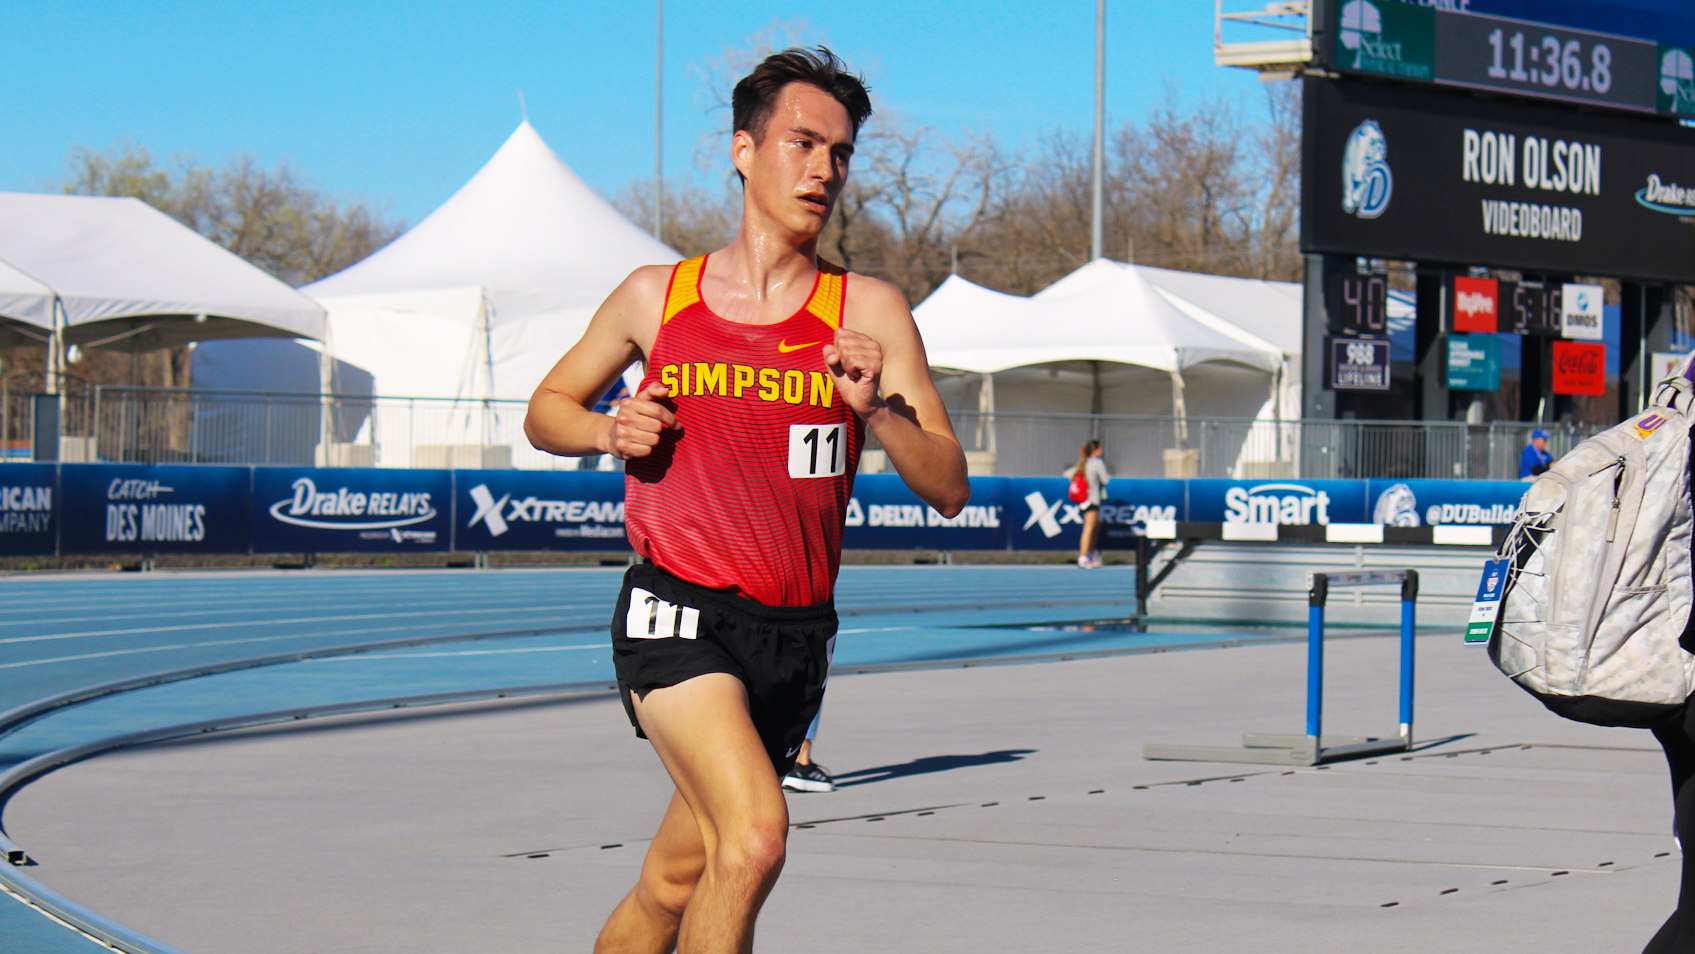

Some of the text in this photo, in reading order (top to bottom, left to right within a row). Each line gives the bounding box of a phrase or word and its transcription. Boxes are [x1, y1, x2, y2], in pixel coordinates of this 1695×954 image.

[1488, 28, 1611, 94] 11:36.8
[1463, 128, 1601, 196] RON OLSON
[1645, 173, 1685, 205] Drake
[1482, 199, 1582, 242] VIDEOBOARD
[1344, 278, 1385, 329] 40
[1346, 343, 1375, 365] 988
[661, 362, 834, 409] SIMPSON
[803, 427, 839, 475] 11
[0, 486, 52, 511] ICAN
[107, 478, 174, 500] CATCH
[289, 477, 432, 516] Drake RELAYS
[1225, 485, 1330, 526] Smart
[106, 504, 206, 542] DES MOINES
[506, 497, 625, 523] XTREAM
[868, 504, 925, 527] DELTA
[1059, 504, 1177, 525] XREAM
